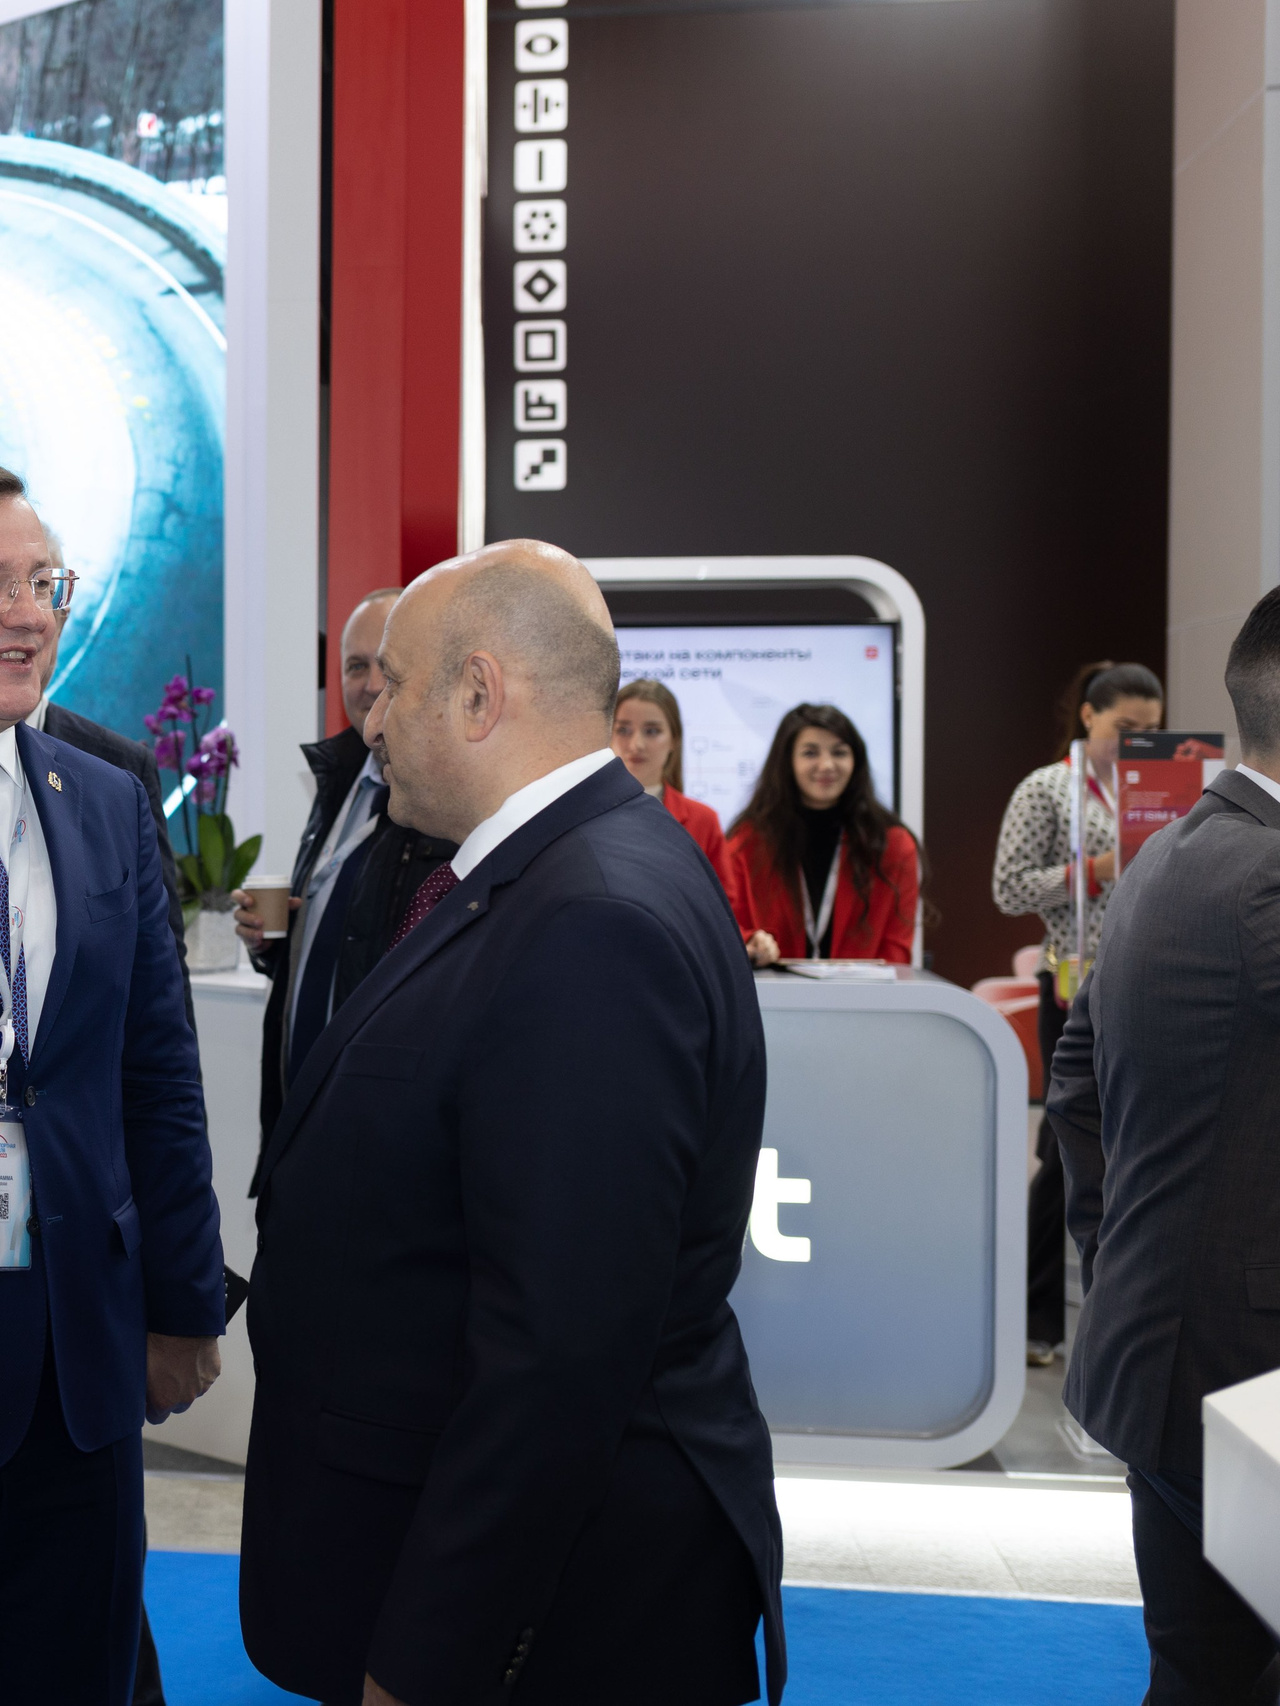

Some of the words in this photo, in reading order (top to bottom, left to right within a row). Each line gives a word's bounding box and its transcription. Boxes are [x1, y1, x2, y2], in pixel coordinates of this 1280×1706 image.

[669, 649, 691, 661] на
[694, 648, 812, 661] компоненты
[680, 667, 722, 679] сети
